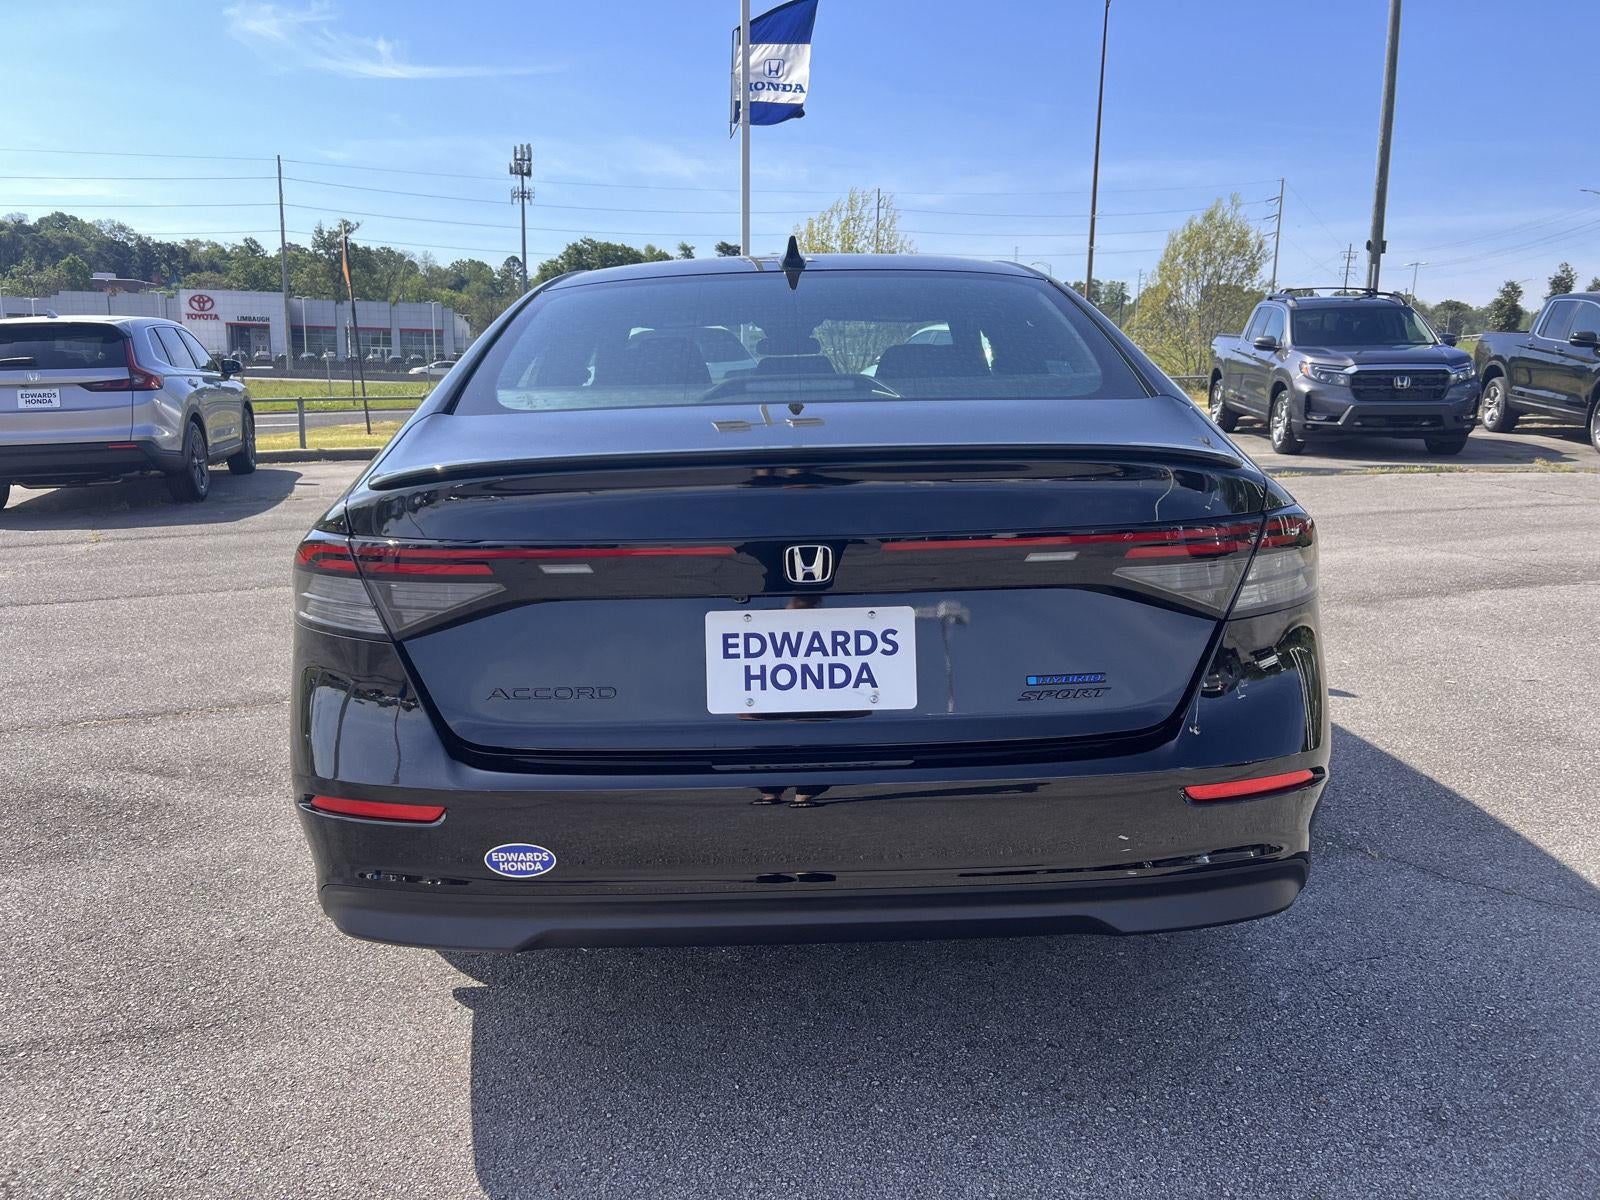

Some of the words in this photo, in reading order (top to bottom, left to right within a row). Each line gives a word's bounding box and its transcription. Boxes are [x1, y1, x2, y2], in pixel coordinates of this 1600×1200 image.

[186, 313, 220, 321] TOYOTA
[722, 628, 899, 660] EDWARDS
[744, 661, 879, 692] HONDA
[1039, 674, 1104, 683] HYBRID
[486, 686, 618, 701] ACCORD
[1017, 686, 1112, 701] SPORT
[491, 852, 550, 862] EDWARDS
[500, 861, 544, 871] HONDA
